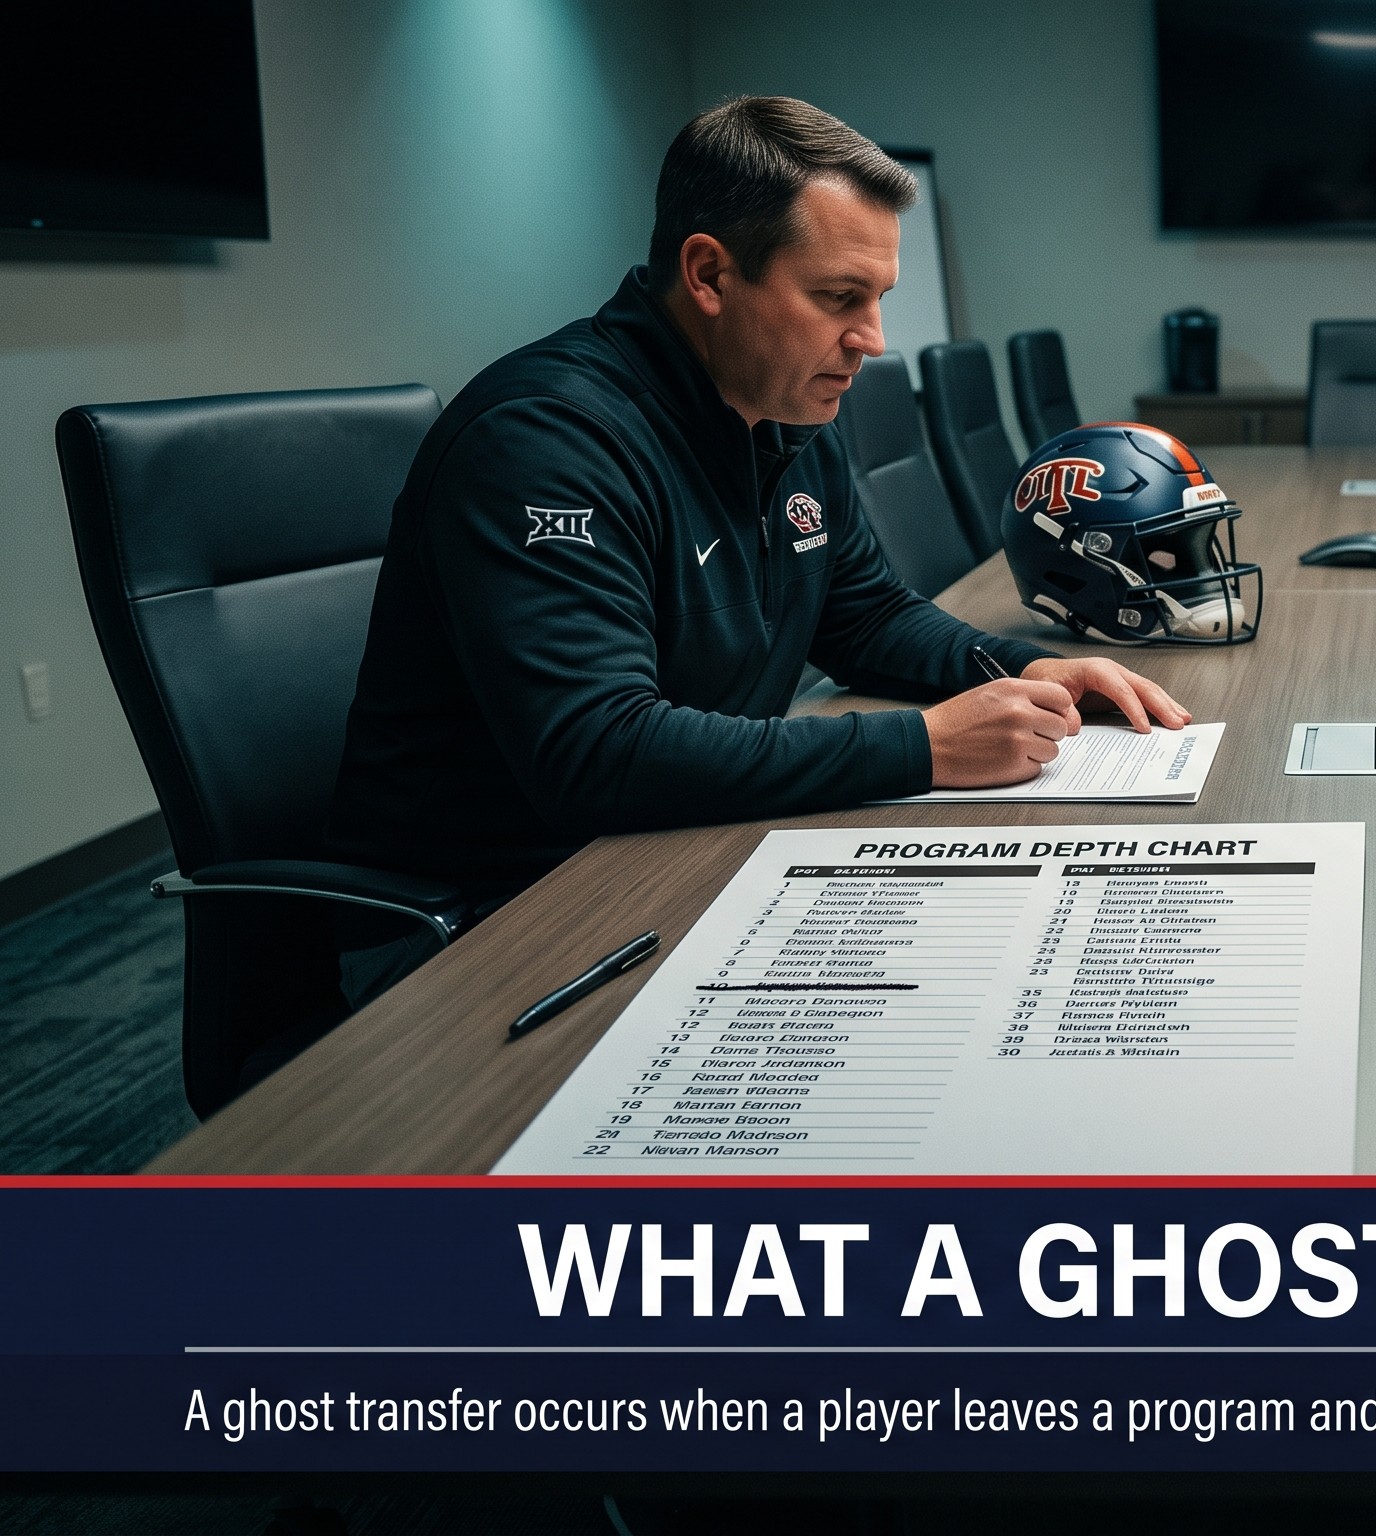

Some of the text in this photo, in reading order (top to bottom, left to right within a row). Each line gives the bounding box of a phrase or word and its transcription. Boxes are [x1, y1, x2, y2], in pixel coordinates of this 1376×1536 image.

[854, 841, 1257, 858] PROGRAM DEPTH CHART
[698, 996, 717, 1004] 11
[1012, 1011, 1036, 1019] 37
[670, 1033, 692, 1041] 13
[1002, 1035, 1026, 1043] 39
[661, 1046, 682, 1054] 14
[997, 1048, 1022, 1056] 30
[651, 1059, 673, 1067] 15
[641, 1072, 663, 1081] 16
[631, 1086, 656, 1094] 17
[621, 1100, 644, 1109] 18
[610, 1114, 634, 1124] 19
[582, 1145, 612, 1154] 22
